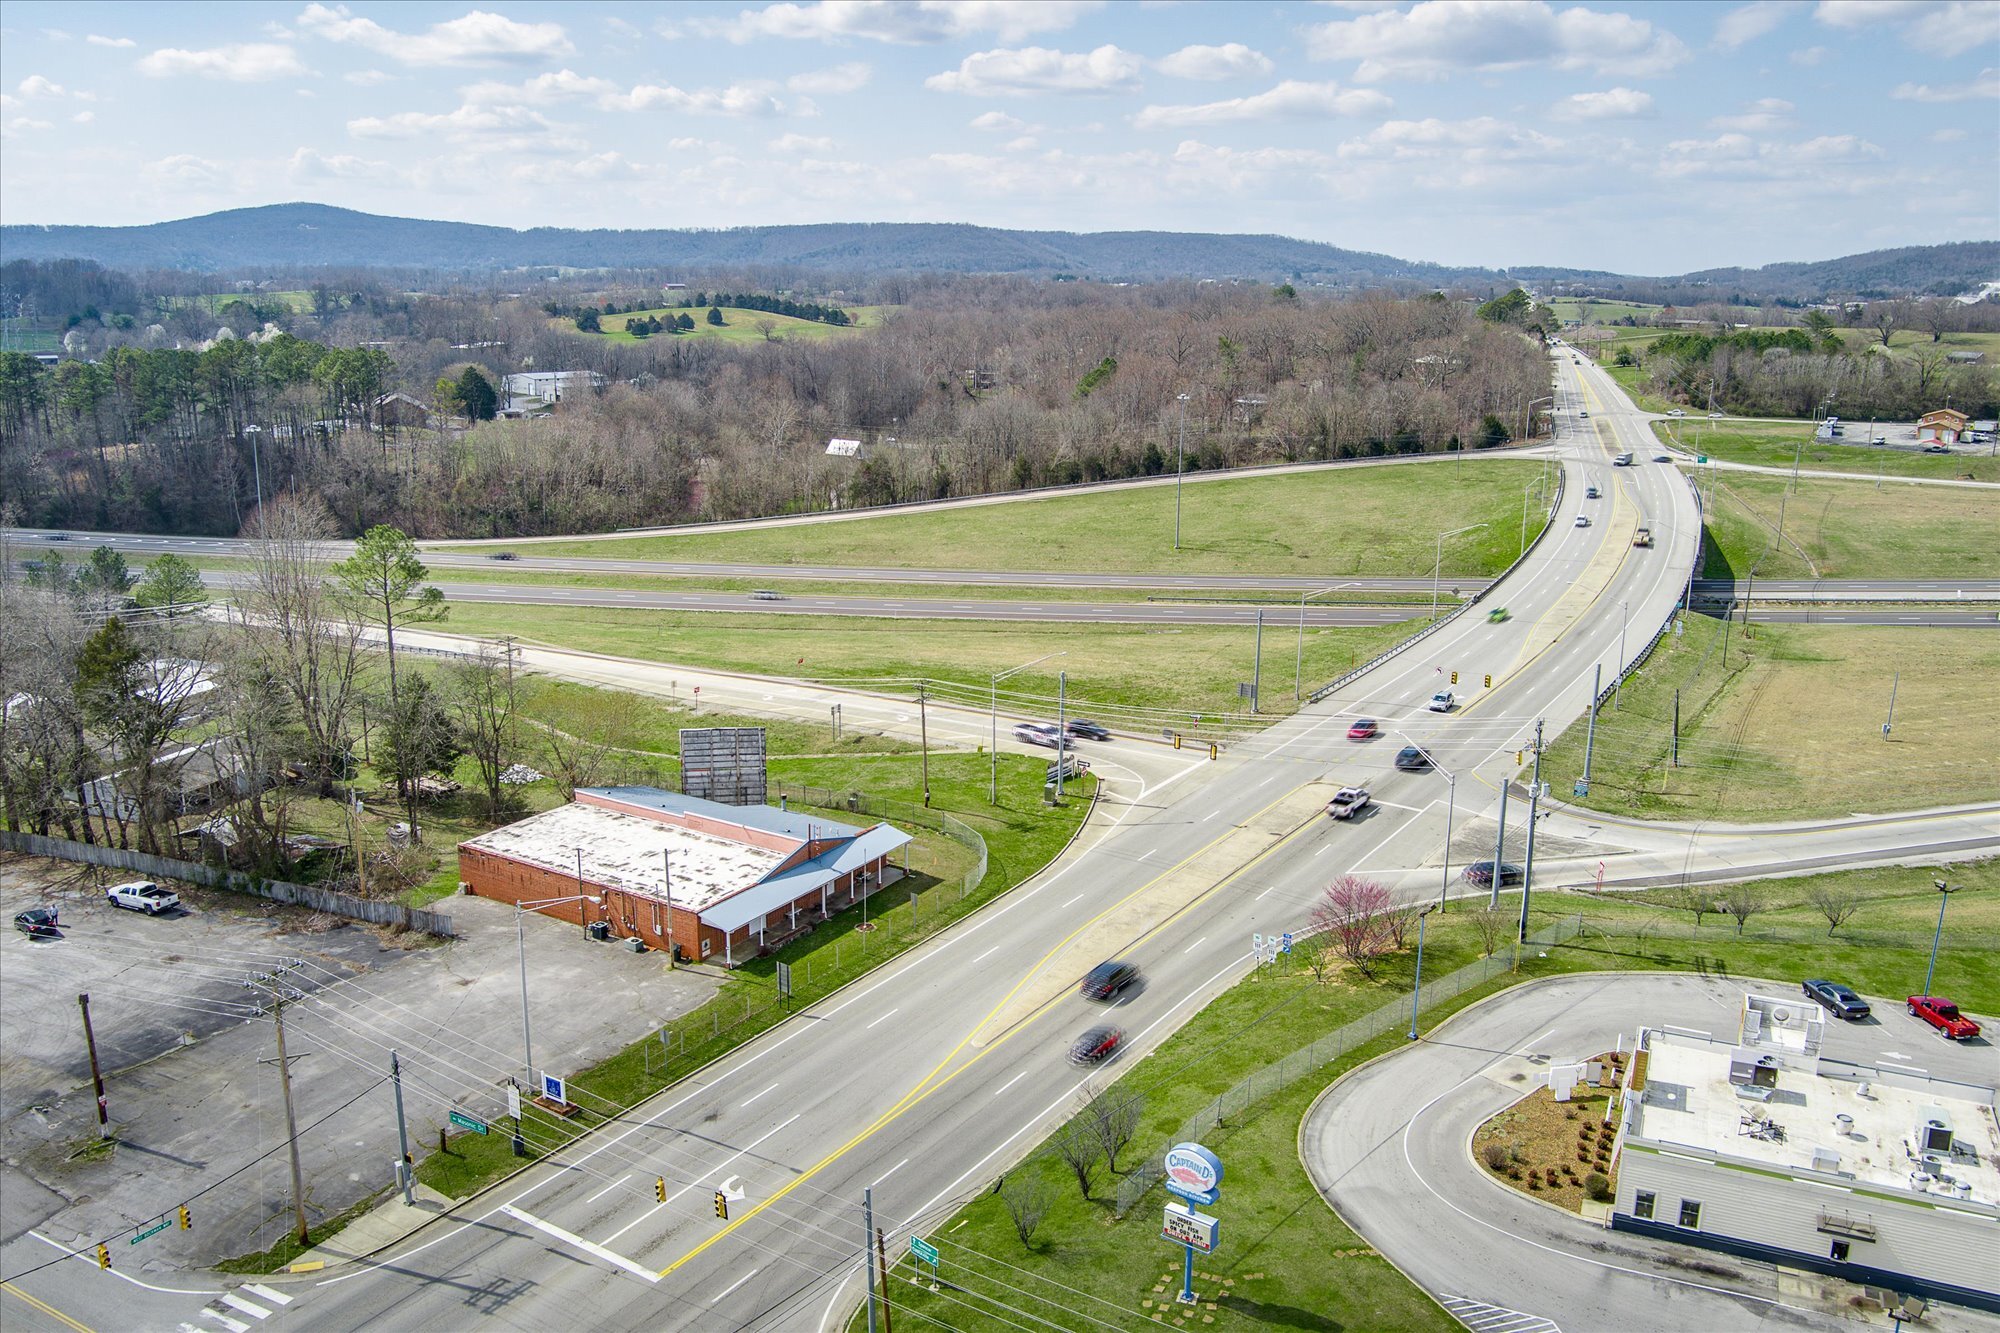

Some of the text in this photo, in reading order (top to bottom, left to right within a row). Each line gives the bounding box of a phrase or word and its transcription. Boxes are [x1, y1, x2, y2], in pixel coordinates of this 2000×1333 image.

[1176, 1216, 1193, 1226] ORDER
[1169, 1219, 1199, 1234] SPICY FISH
[1192, 1234, 1204, 1242] APP
